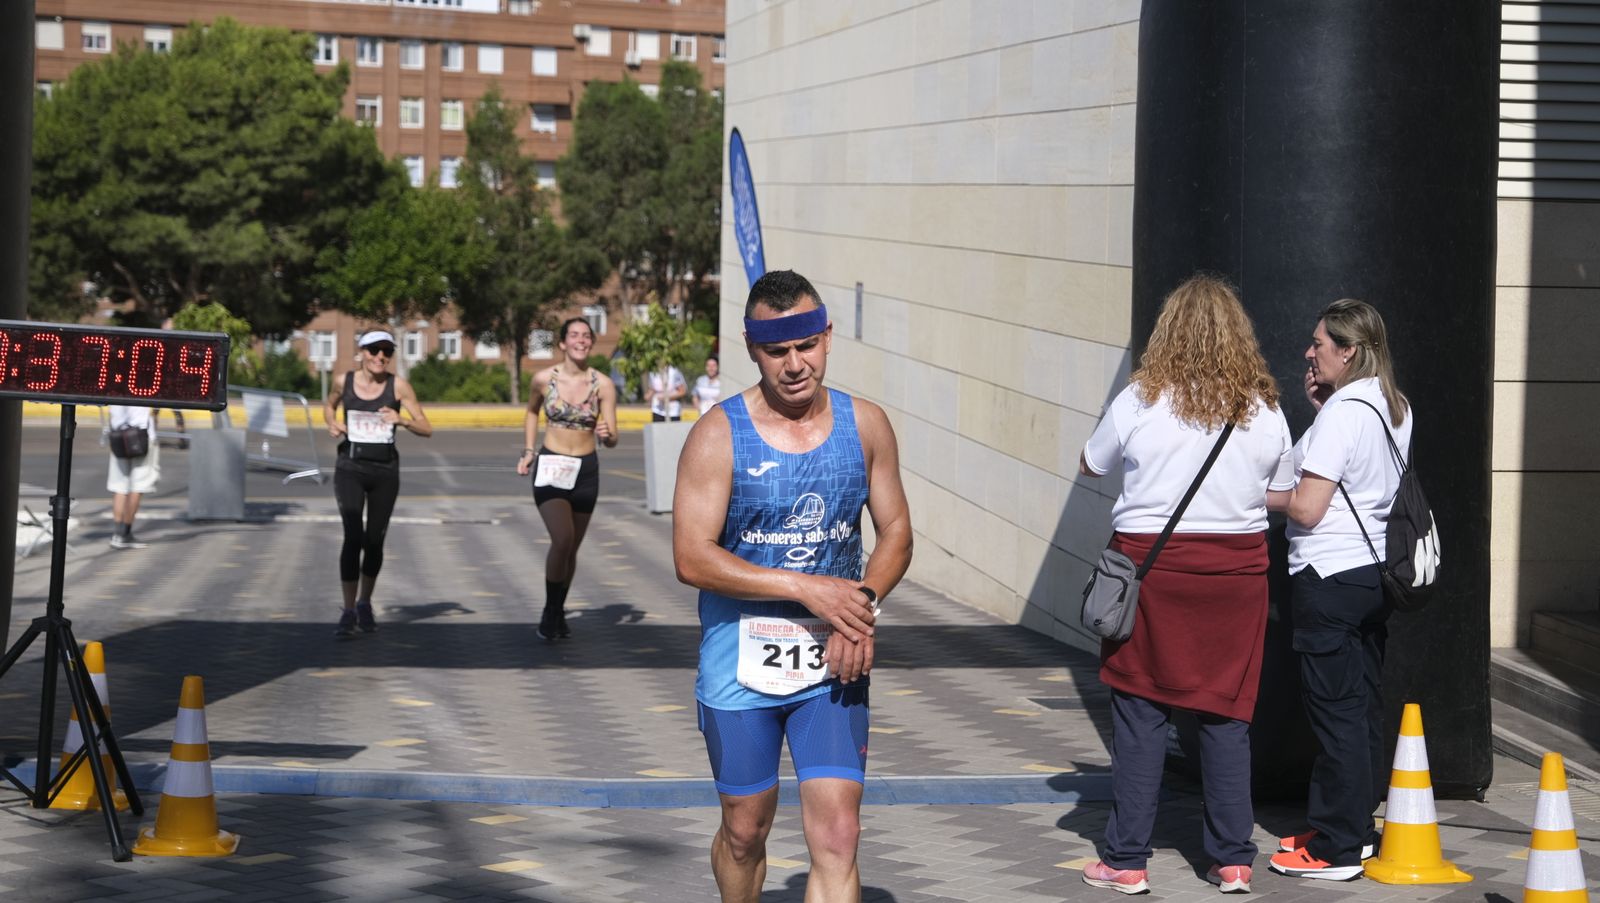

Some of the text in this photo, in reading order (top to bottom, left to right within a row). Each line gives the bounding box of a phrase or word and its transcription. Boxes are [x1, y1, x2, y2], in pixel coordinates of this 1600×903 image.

[741, 529, 803, 545] Carboneras
[756, 623, 794, 633] CARRERA
[796, 624, 810, 634] SIN
[762, 643, 826, 671] 213
